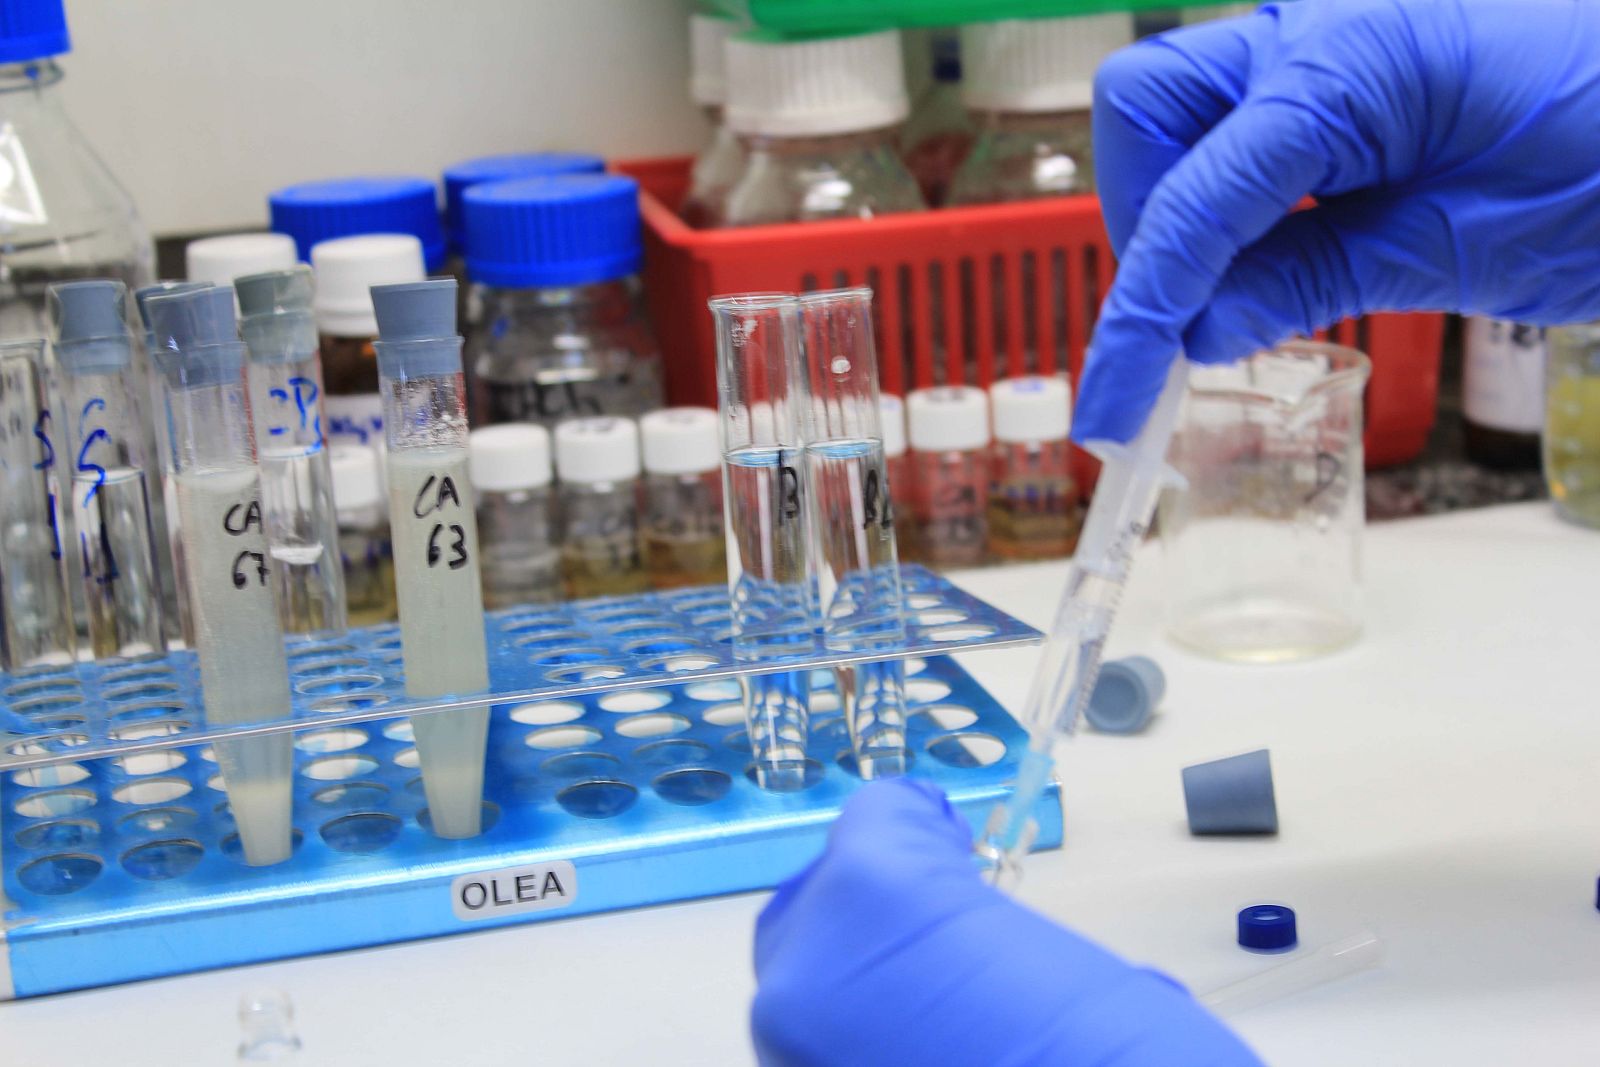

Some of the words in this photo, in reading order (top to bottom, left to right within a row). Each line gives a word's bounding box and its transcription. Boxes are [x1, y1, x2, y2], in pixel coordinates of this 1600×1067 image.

[413, 474, 461, 519] CA
[223, 500, 263, 537] CA
[427, 523, 468, 570] 63
[461, 870, 566, 911] OLEA
